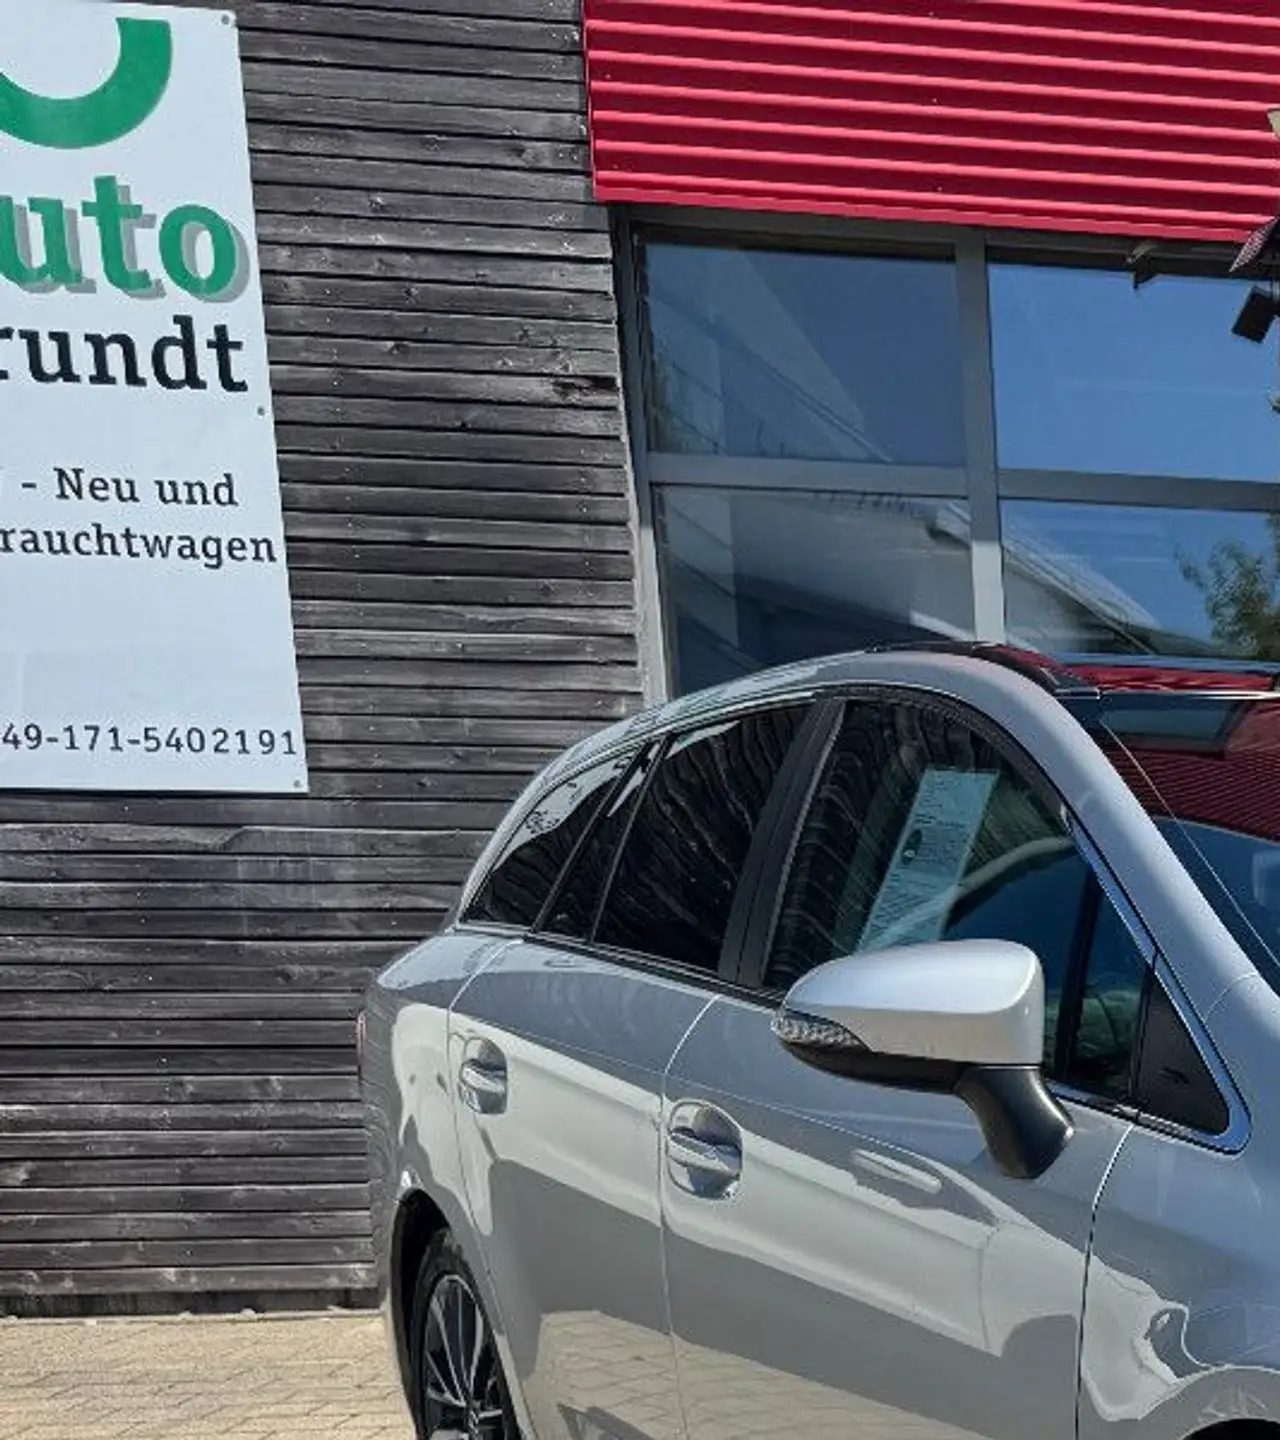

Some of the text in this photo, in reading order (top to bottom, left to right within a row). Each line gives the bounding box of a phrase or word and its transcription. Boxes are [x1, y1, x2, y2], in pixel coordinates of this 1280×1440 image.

[0, 175, 250, 303] uto
[53, 467, 140, 503] Neu
[154, 473, 239, 507] und
[0, 523, 277, 569] rauchtwagen
[2, 723, 297, 755] 49-171-5402191
